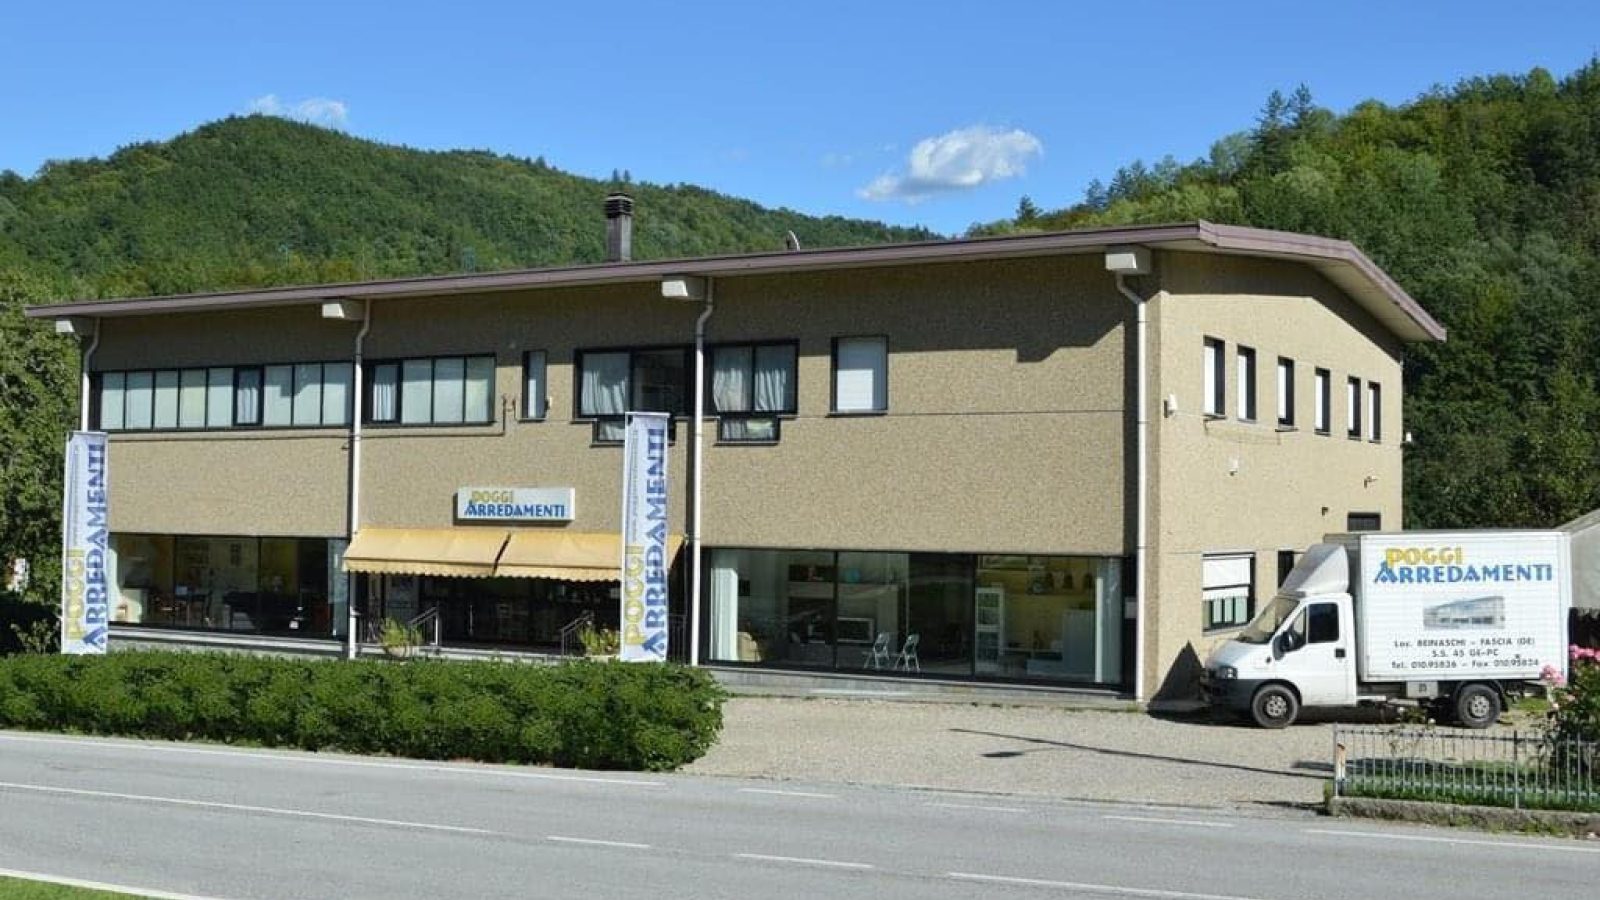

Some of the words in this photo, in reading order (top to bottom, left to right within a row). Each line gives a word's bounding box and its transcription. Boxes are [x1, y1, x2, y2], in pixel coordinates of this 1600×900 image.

[472, 490, 513, 503] POGGI
[464, 499, 565, 518] ARREDAMENTI
[83, 444, 107, 650] ARREDAMENTI
[642, 428, 667, 657] ARREDAMENTI
[1385, 547, 1463, 567] POGGI
[1374, 561, 1552, 584] ARREDAMENTI
[66, 549, 85, 640] POGGI
[625, 545, 645, 645] POGGI
[1480, 637, 1513, 646] FASCIA
